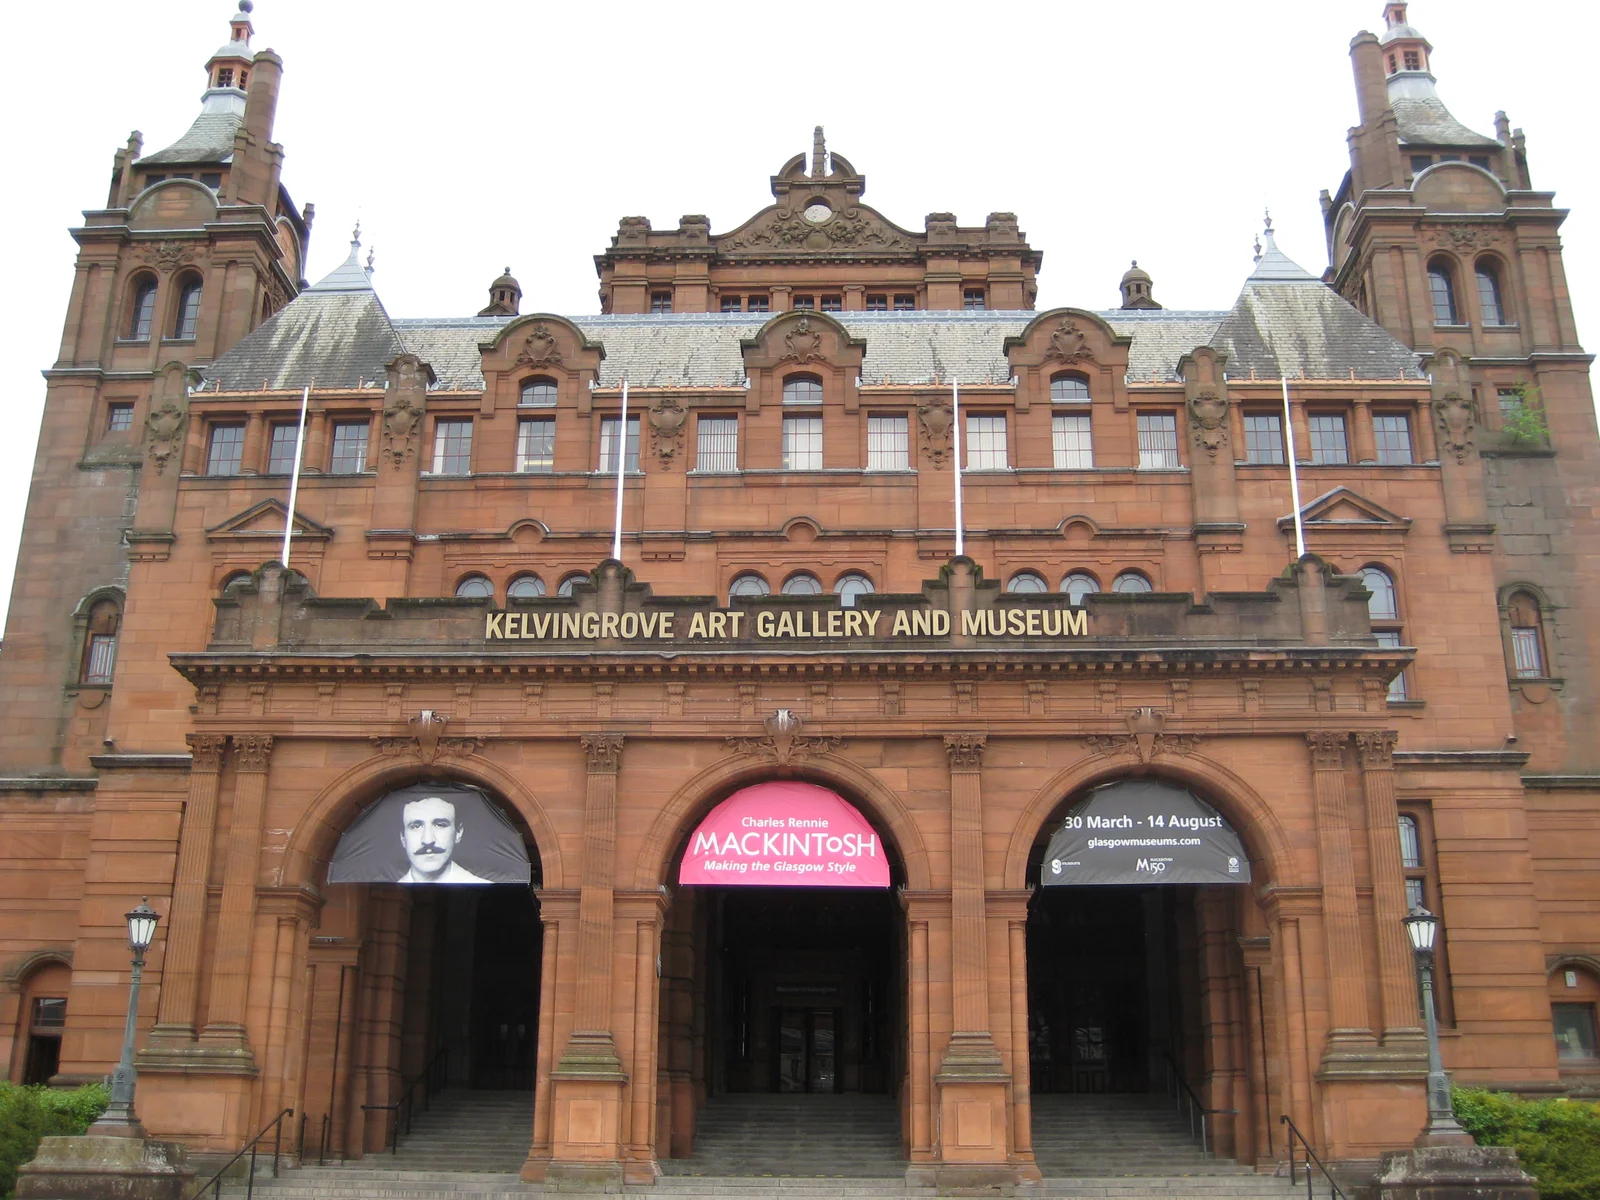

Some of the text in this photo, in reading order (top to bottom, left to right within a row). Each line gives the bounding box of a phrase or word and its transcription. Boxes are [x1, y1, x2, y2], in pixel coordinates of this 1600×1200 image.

[485, 609, 1088, 639] KELVINGROVE ART GALLERY AND MUSEUM
[741, 816, 829, 828] Charles Rennie
[1065, 816, 1083, 829] 30
[1087, 815, 1133, 829] March
[1147, 815, 1165, 828] 14
[1169, 815, 1223, 831] August
[1087, 836, 1201, 849] glasgowmuseums.com
[703, 860, 857, 873] Making the Glasgow Style
